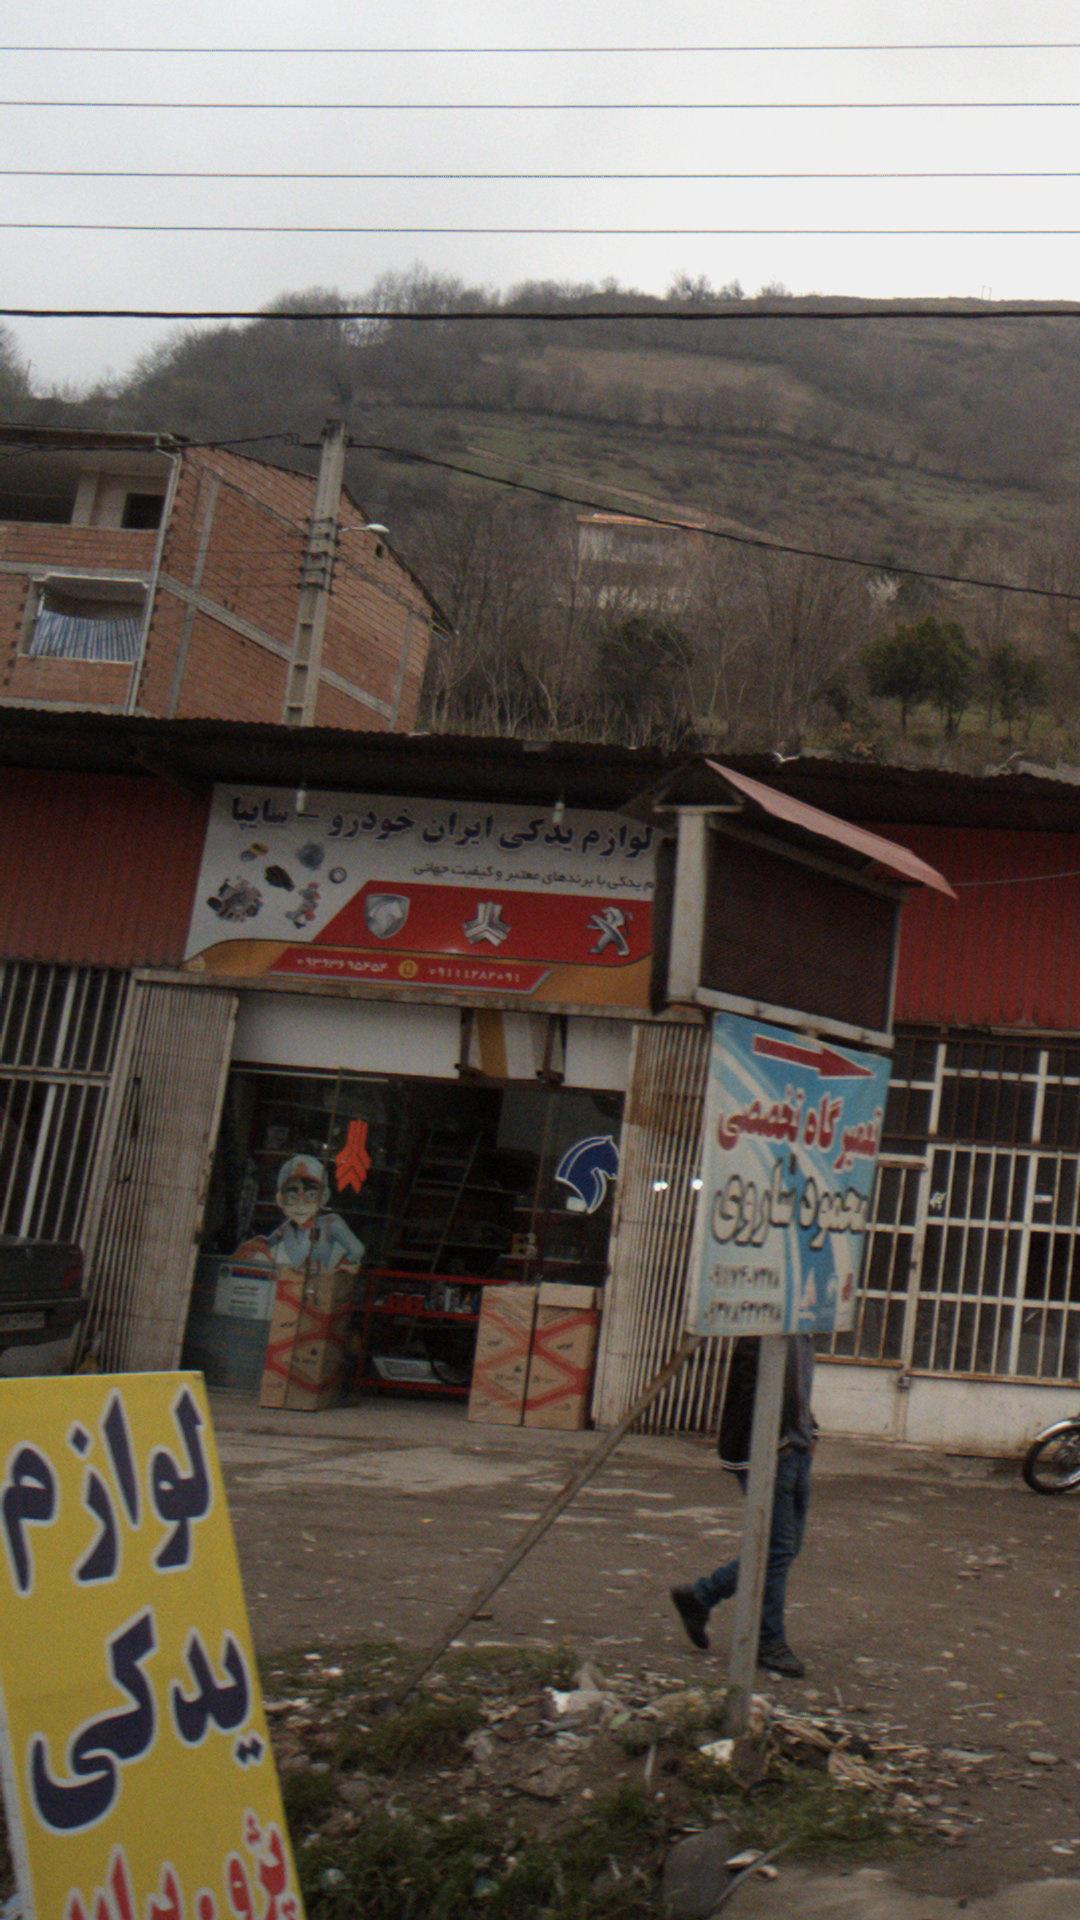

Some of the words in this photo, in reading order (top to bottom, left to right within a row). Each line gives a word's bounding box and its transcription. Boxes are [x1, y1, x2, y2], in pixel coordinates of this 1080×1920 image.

[232, 797, 289, 831] سایپا
[327, 809, 415, 841] خودرو
[422, 812, 493, 846] ایران
[500, 819, 573, 851] یدکی
[581, 823, 653, 858] لوازم
[1, 1388, 210, 1593] لوازم
[32, 1610, 263, 1830] یدکی
